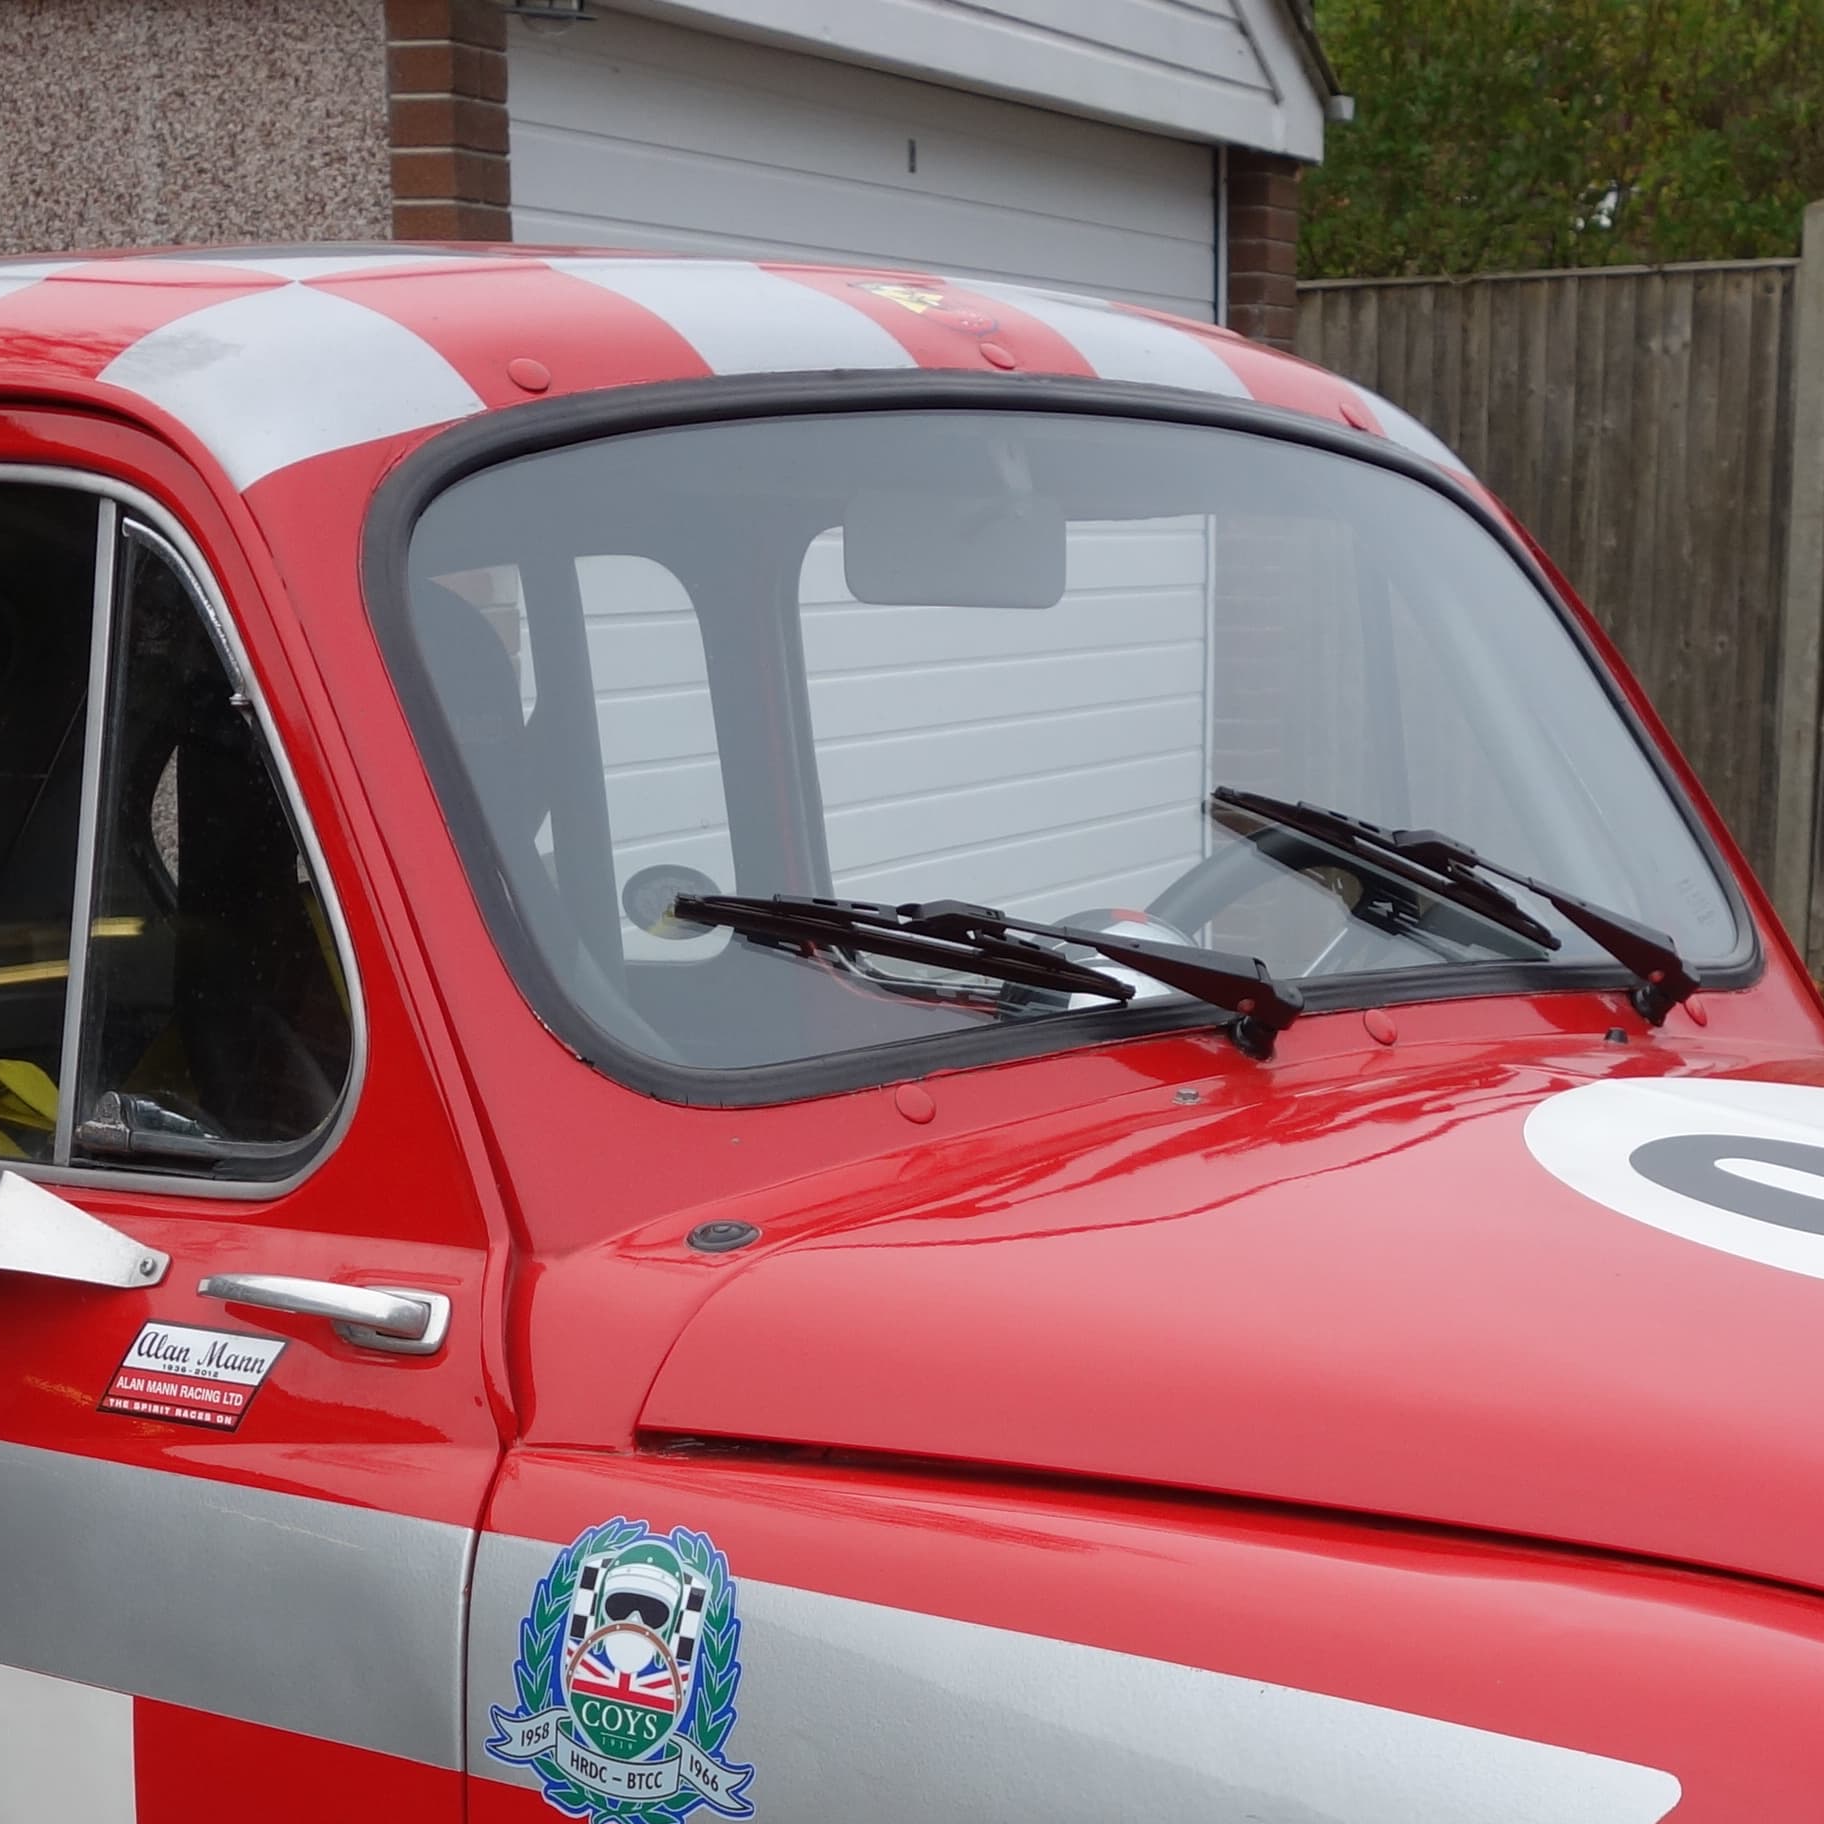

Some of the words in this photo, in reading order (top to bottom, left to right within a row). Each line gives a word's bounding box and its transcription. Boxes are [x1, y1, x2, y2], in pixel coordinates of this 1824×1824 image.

[137, 1331, 191, 1364] Alan
[197, 1340, 265, 1375] Mann
[116, 1375, 145, 1391] ALAN
[146, 1379, 177, 1395] MANN
[179, 1384, 221, 1402] RACING
[222, 1392, 244, 1406] LTD
[108, 1398, 129, 1409] THE
[133, 1402, 171, 1415] SPIRIT
[175, 1407, 211, 1422] RACES
[216, 1415, 233, 1425] ON
[581, 1700, 658, 1740] COYS
[520, 1722, 550, 1747] 1958
[570, 1750, 608, 1783] HRDC
[627, 1771, 663, 1790] BTCC
[689, 1755, 720, 1792] 1966
